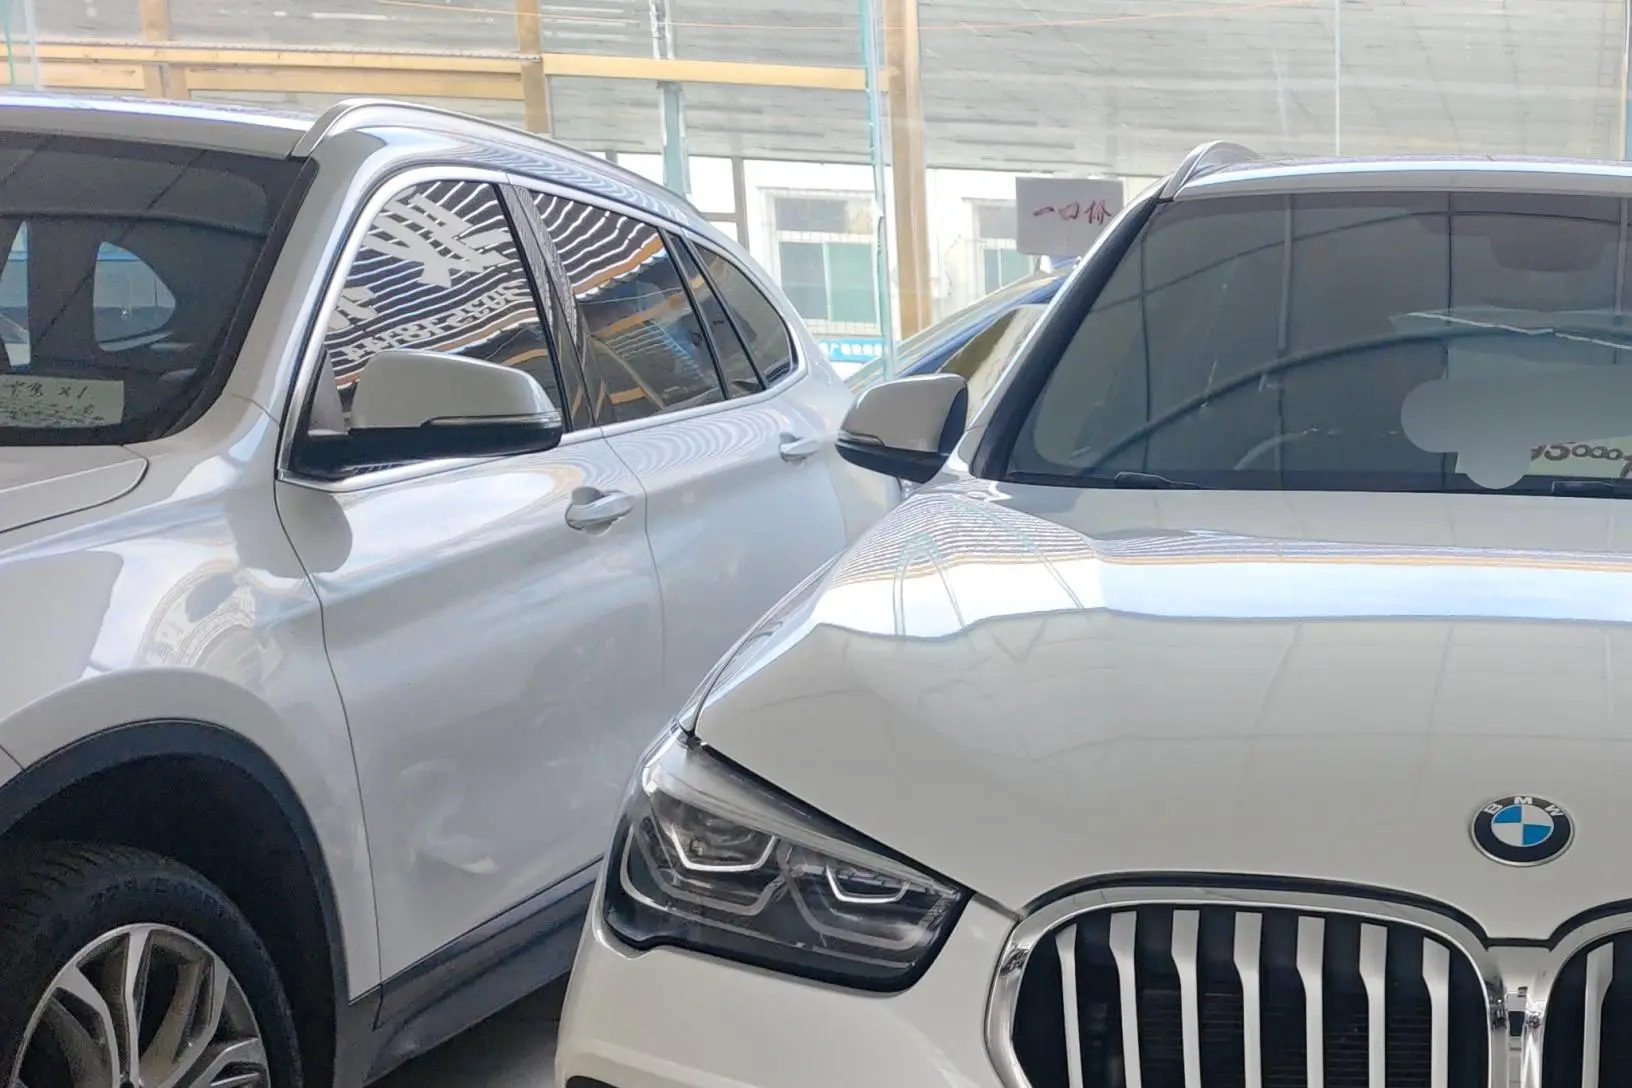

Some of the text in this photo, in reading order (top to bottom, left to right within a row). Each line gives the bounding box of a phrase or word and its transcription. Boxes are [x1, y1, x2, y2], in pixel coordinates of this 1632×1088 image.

[1031, 200, 1112, 225] 一口价
[1484, 796, 1564, 816] BMW
